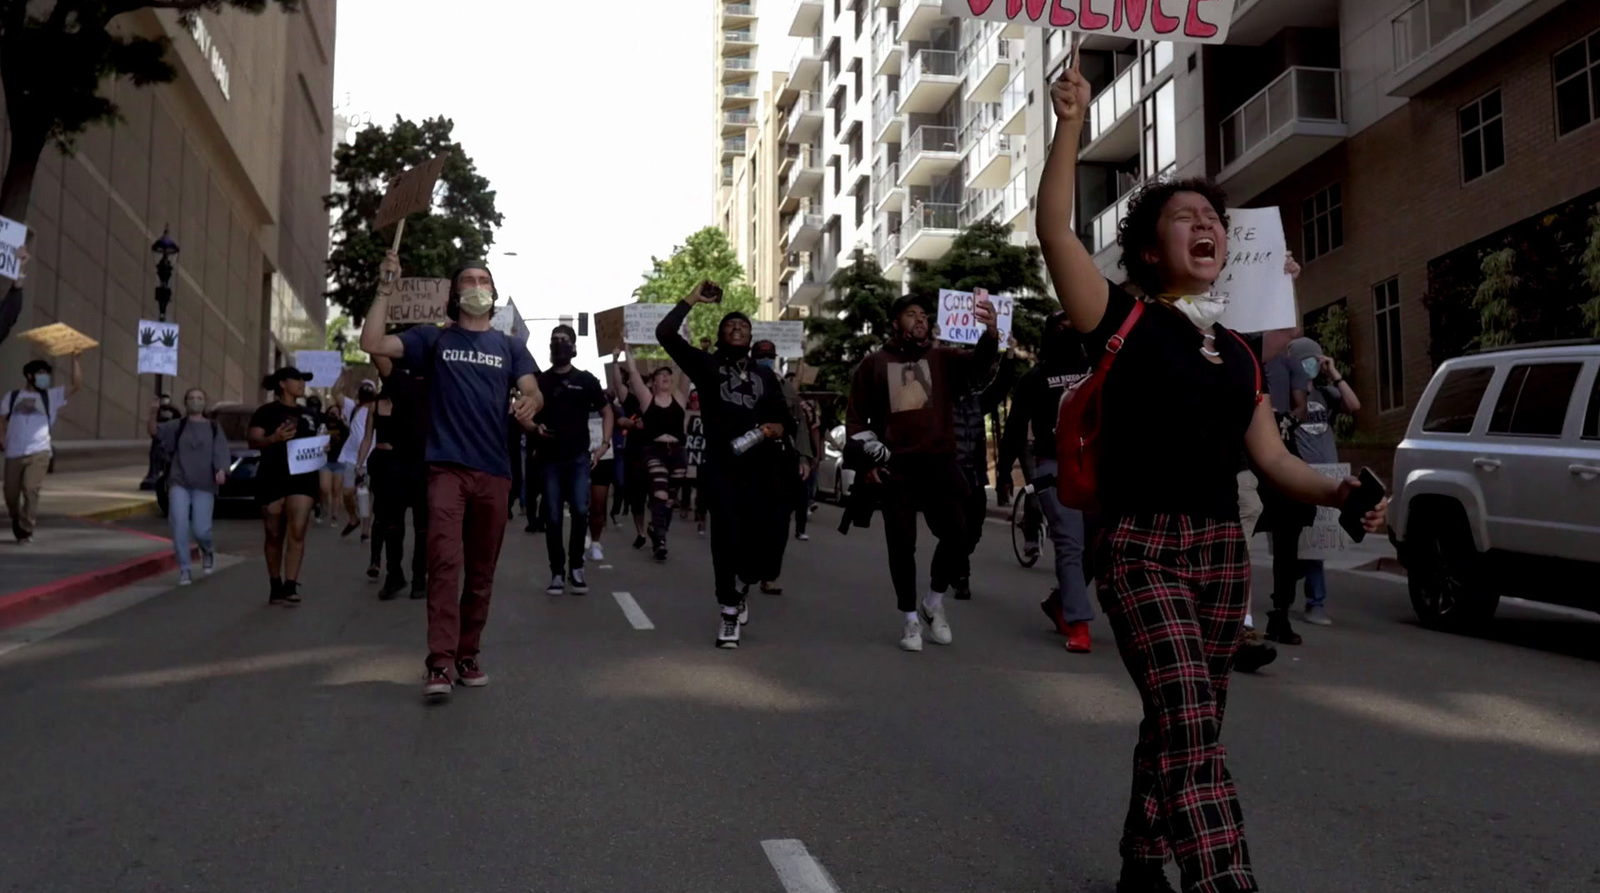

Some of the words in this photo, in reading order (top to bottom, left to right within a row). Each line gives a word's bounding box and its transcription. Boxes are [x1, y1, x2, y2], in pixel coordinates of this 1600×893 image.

[396, 279, 442, 294] UNITY
[944, 293, 974, 312] COLO
[997, 300, 1011, 316] IS
[386, 305, 410, 320] NEW
[948, 328, 980, 341] CRIM
[442, 349, 503, 368] COLLEGE
[1047, 376, 1061, 385] SAN
